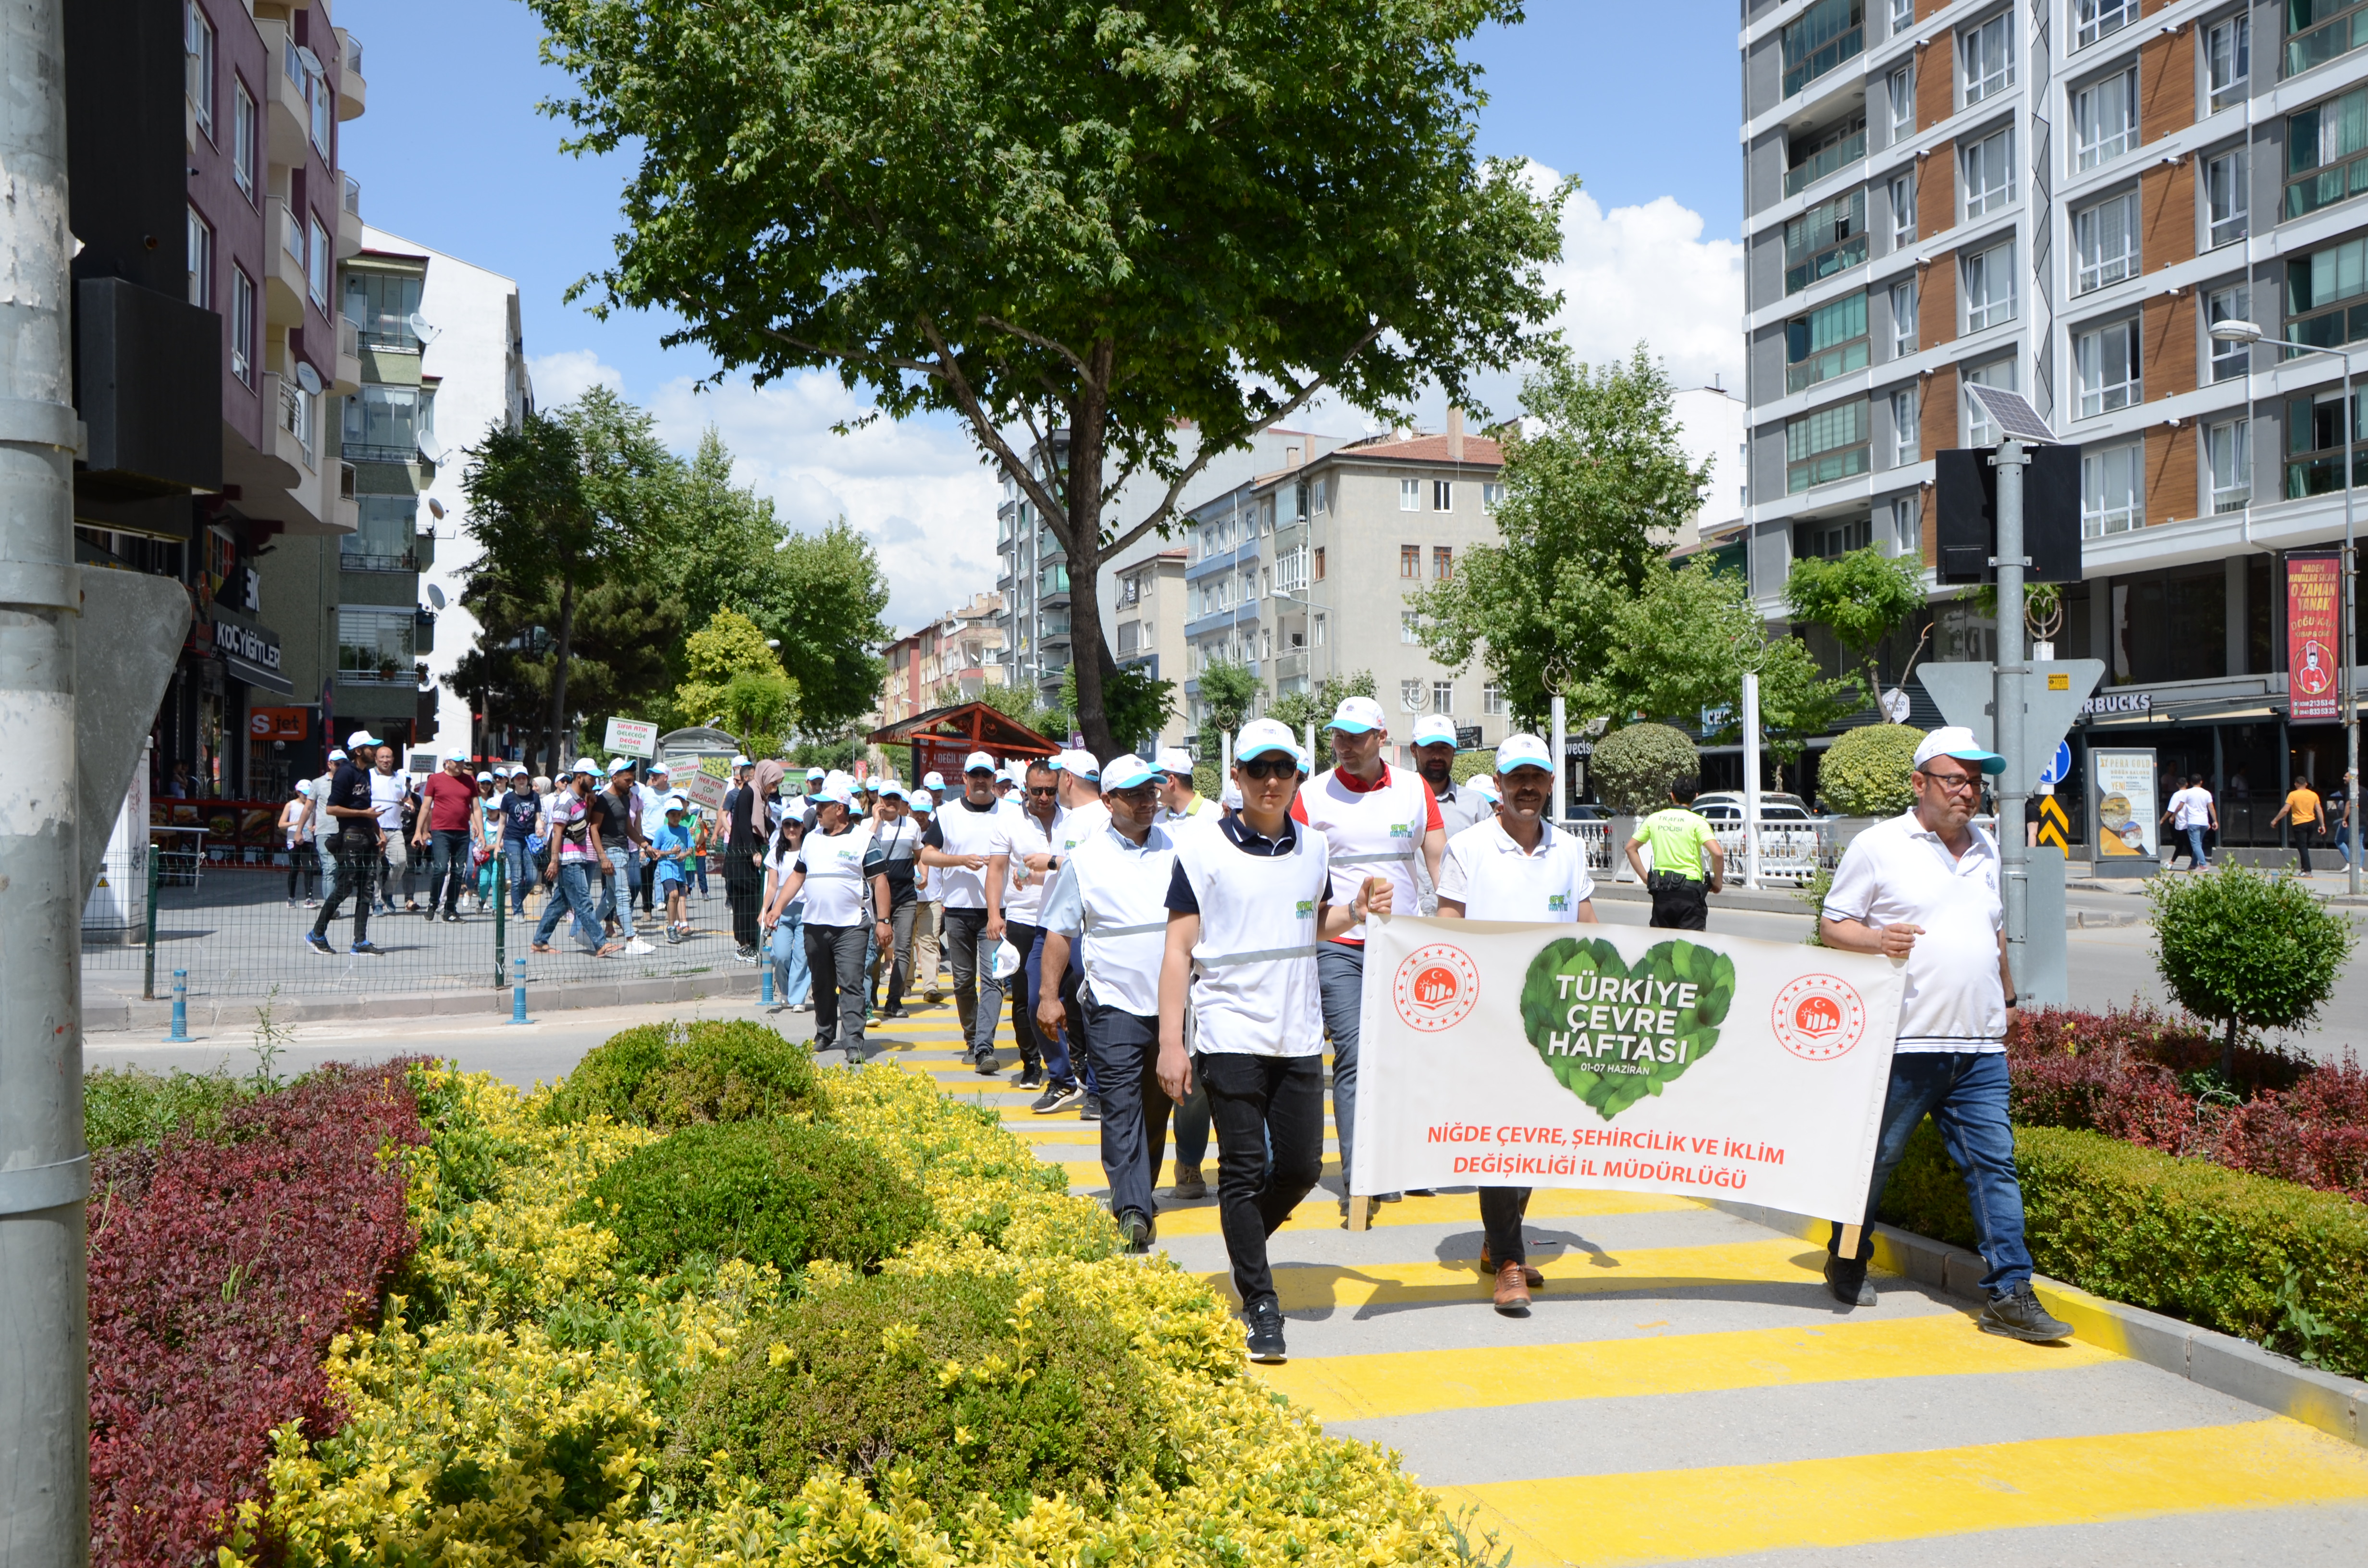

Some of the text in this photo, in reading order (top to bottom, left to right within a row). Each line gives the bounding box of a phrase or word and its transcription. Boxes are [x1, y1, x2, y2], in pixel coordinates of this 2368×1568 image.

[2302, 564, 2324, 573] MADEM
[2289, 574, 2318, 583] HAVALAR
[2291, 583, 2336, 597] O ZAMAN
[2297, 597, 2331, 611] YANAK
[217, 621, 280, 669] KOÇYİĞİTLER
[272, 715, 299, 733] jet
[617, 730, 646, 739] GELECEĞE
[938, 752, 956, 763] DEĞİL
[2110, 759, 2150, 768] PERA GOLD
[672, 764, 699, 772] KORUMAK
[698, 776, 723, 790] HER ATIK
[703, 785, 714, 794] ÇÖP
[2111, 781, 2125, 790] YENİ
[691, 791, 717, 806] DEĞİLDİR.
[1555, 970, 1698, 1008] TÜRKİYE
[1566, 1004, 1678, 1035] ÇEVRE
[1547, 1031, 1688, 1064] HAFTASI
[1580, 1062, 1650, 1075] 01-07 HAZİRAN
[1428, 1122, 1785, 1165] NİĞDE ÇEVRE, ŞEHİRCİLİK VE İKLİM
[1454, 1152, 1576, 1178] DEĞİŞİKLİĞİ
[1603, 1159, 1747, 1189] MÜDÜRLÜĞÜ
